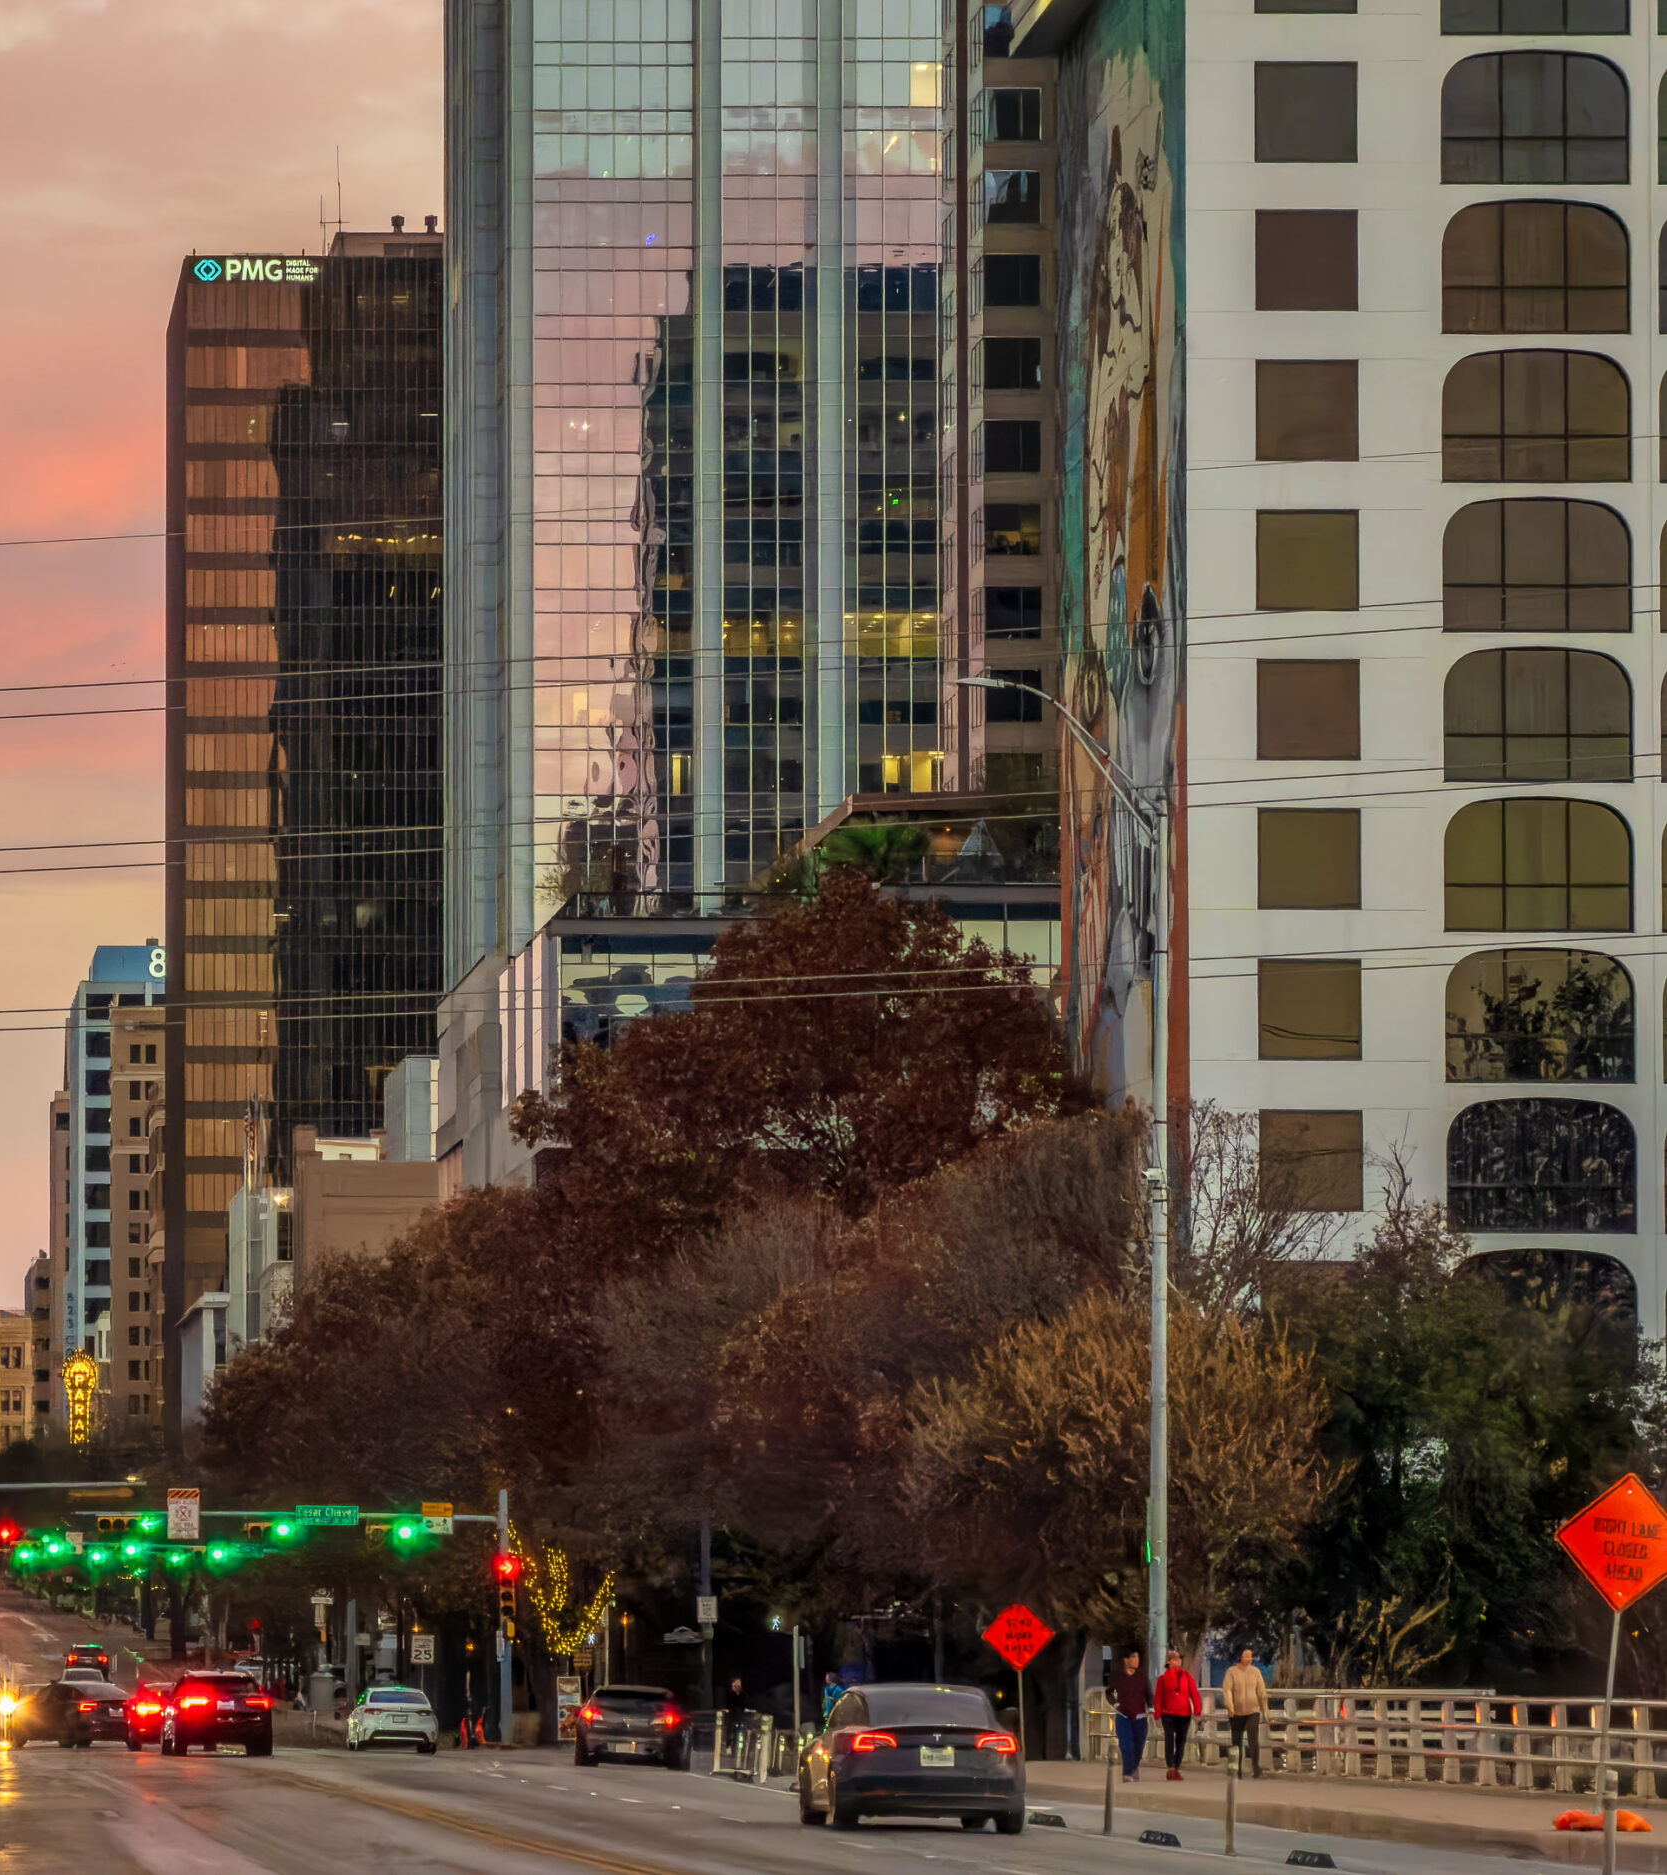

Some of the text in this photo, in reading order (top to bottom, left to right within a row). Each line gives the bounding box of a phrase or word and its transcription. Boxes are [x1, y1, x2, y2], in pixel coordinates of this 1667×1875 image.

[226, 259, 283, 281] PMG
[286, 259, 311, 267] DIGITAL
[1593, 1517, 1663, 1540] RIGHT LANE
[1604, 1540, 1648, 1560] CLOSED
[1605, 1562, 1644, 1582] AHEAD
[413, 1649, 432, 1660] 25
